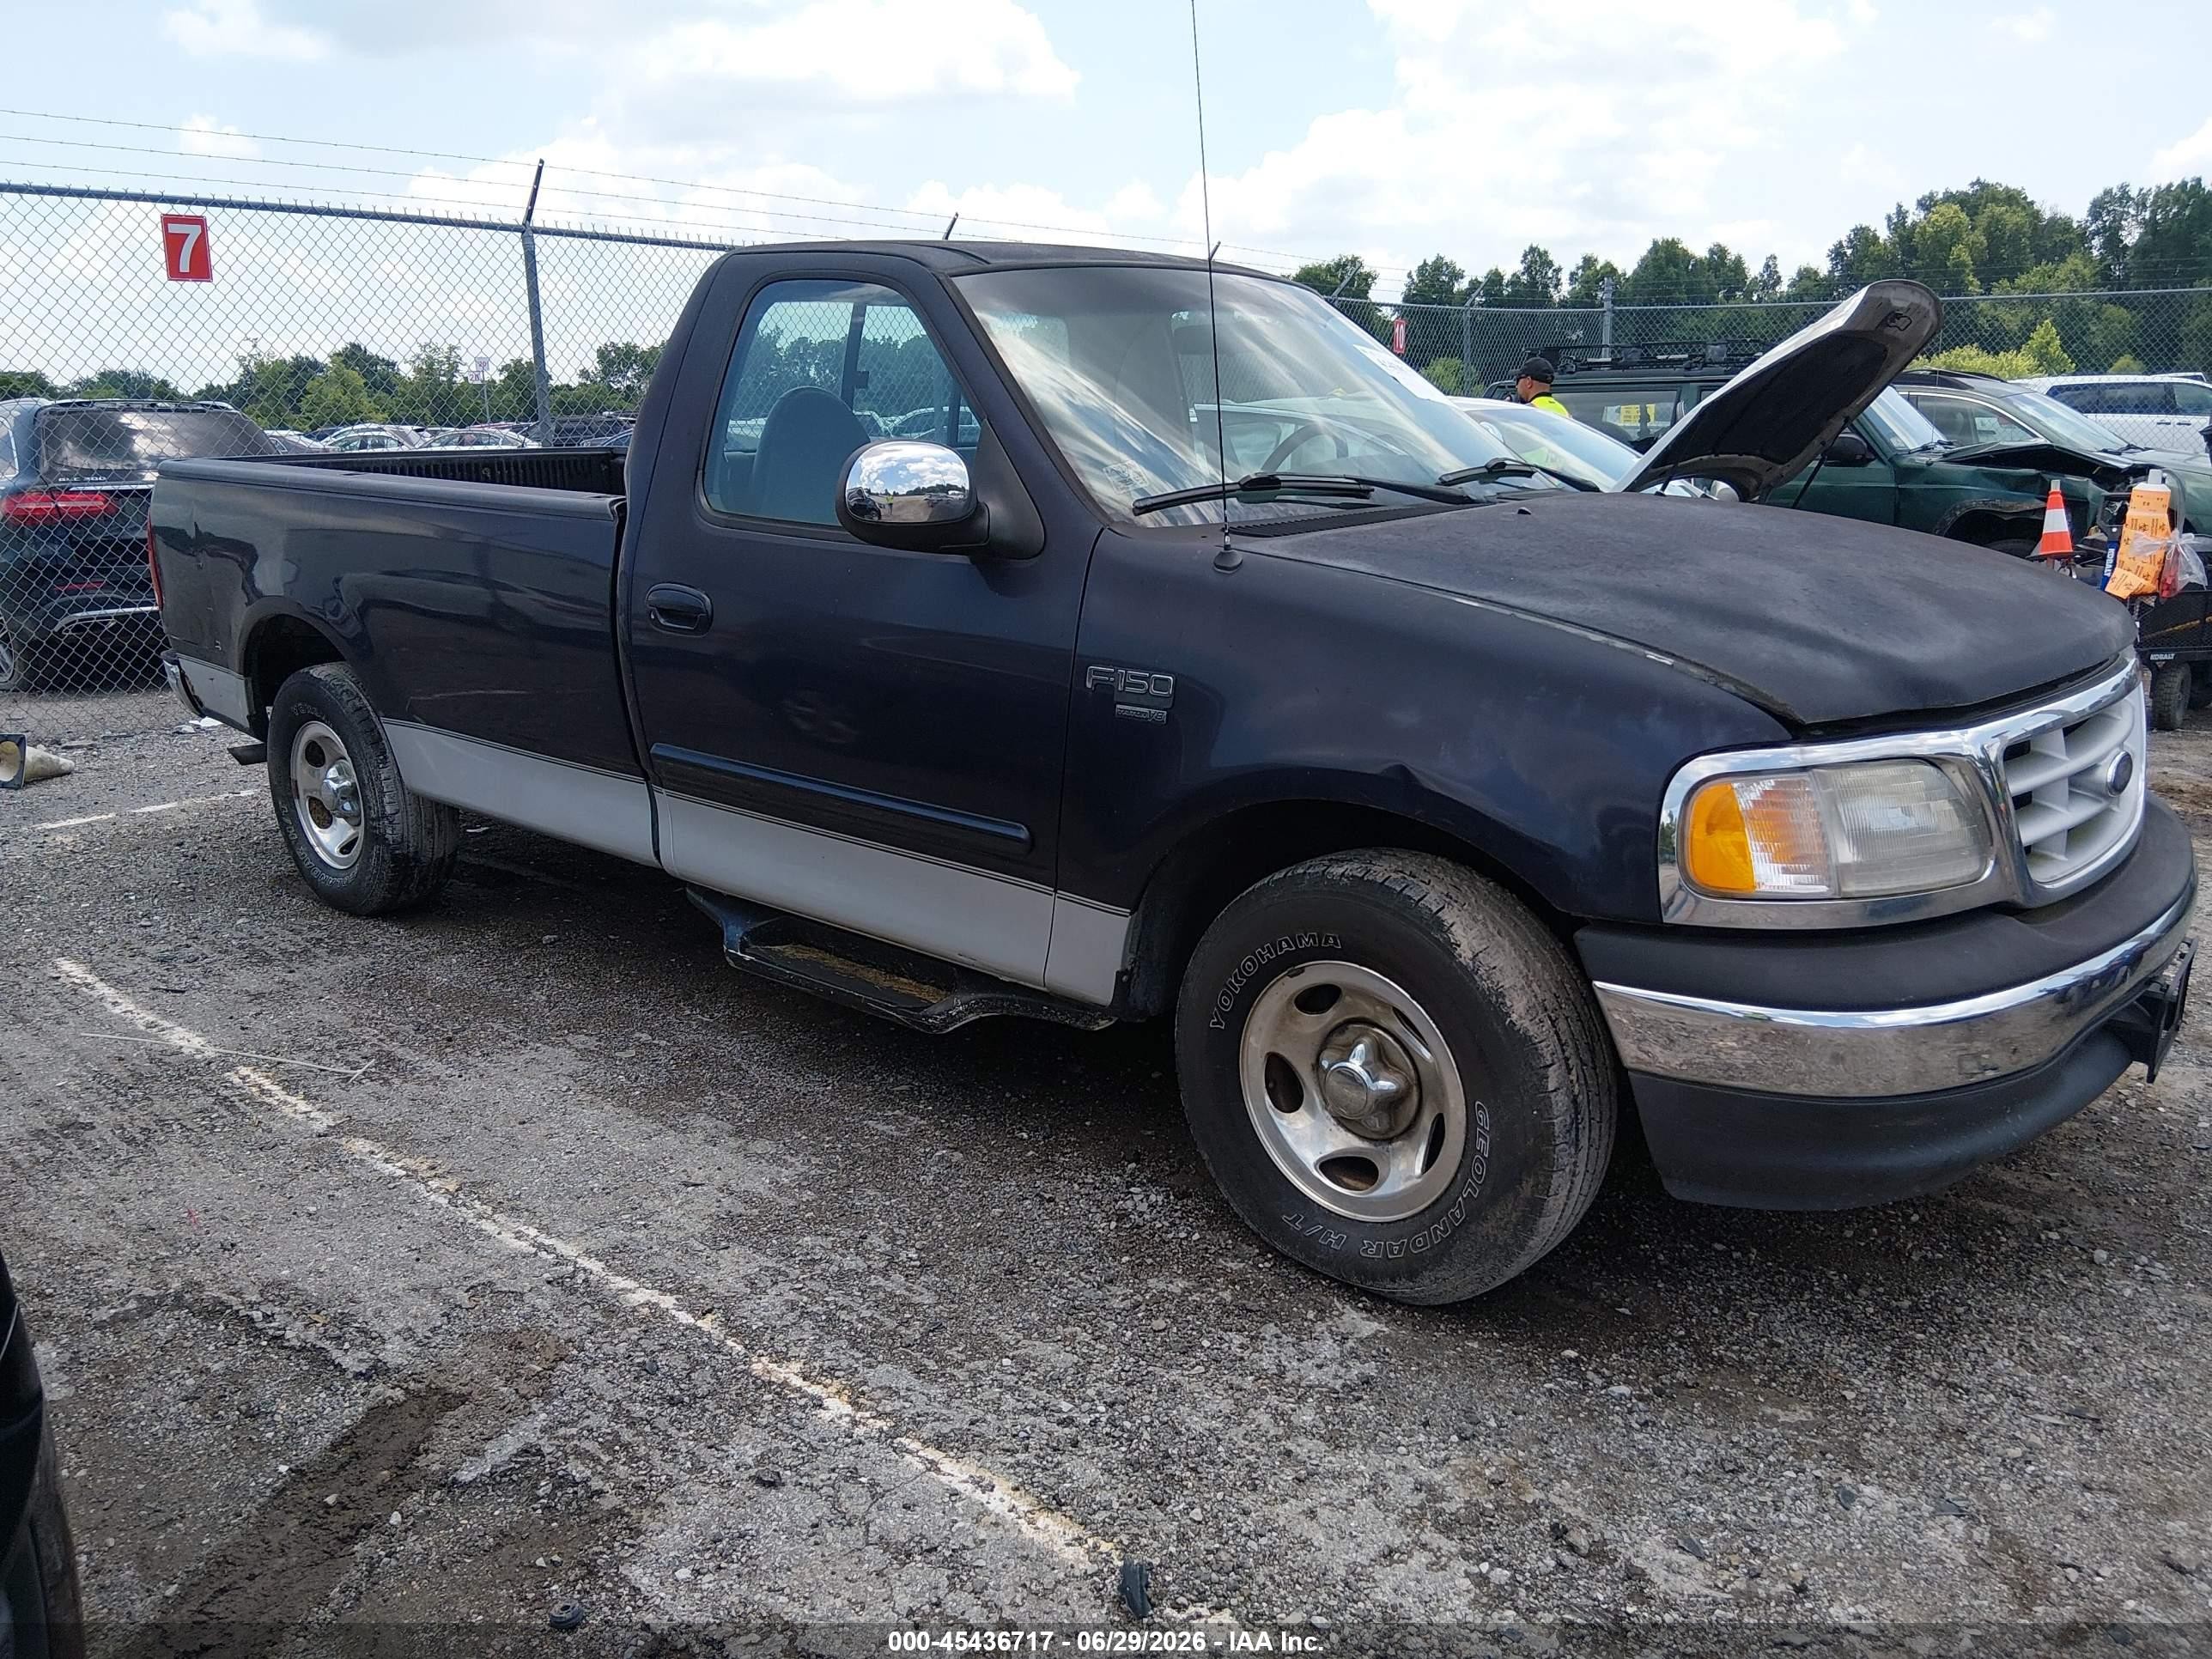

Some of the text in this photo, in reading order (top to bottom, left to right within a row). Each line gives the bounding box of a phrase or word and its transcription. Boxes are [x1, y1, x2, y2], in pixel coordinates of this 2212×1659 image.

[167, 223, 202, 272] 7
[1395, 323, 1405, 349] 10
[1149, 709, 1166, 722] V8
[1210, 933, 1341, 1030] YOKOHAMA
[1282, 1101, 1490, 1259] GEOLANDAR H/T
